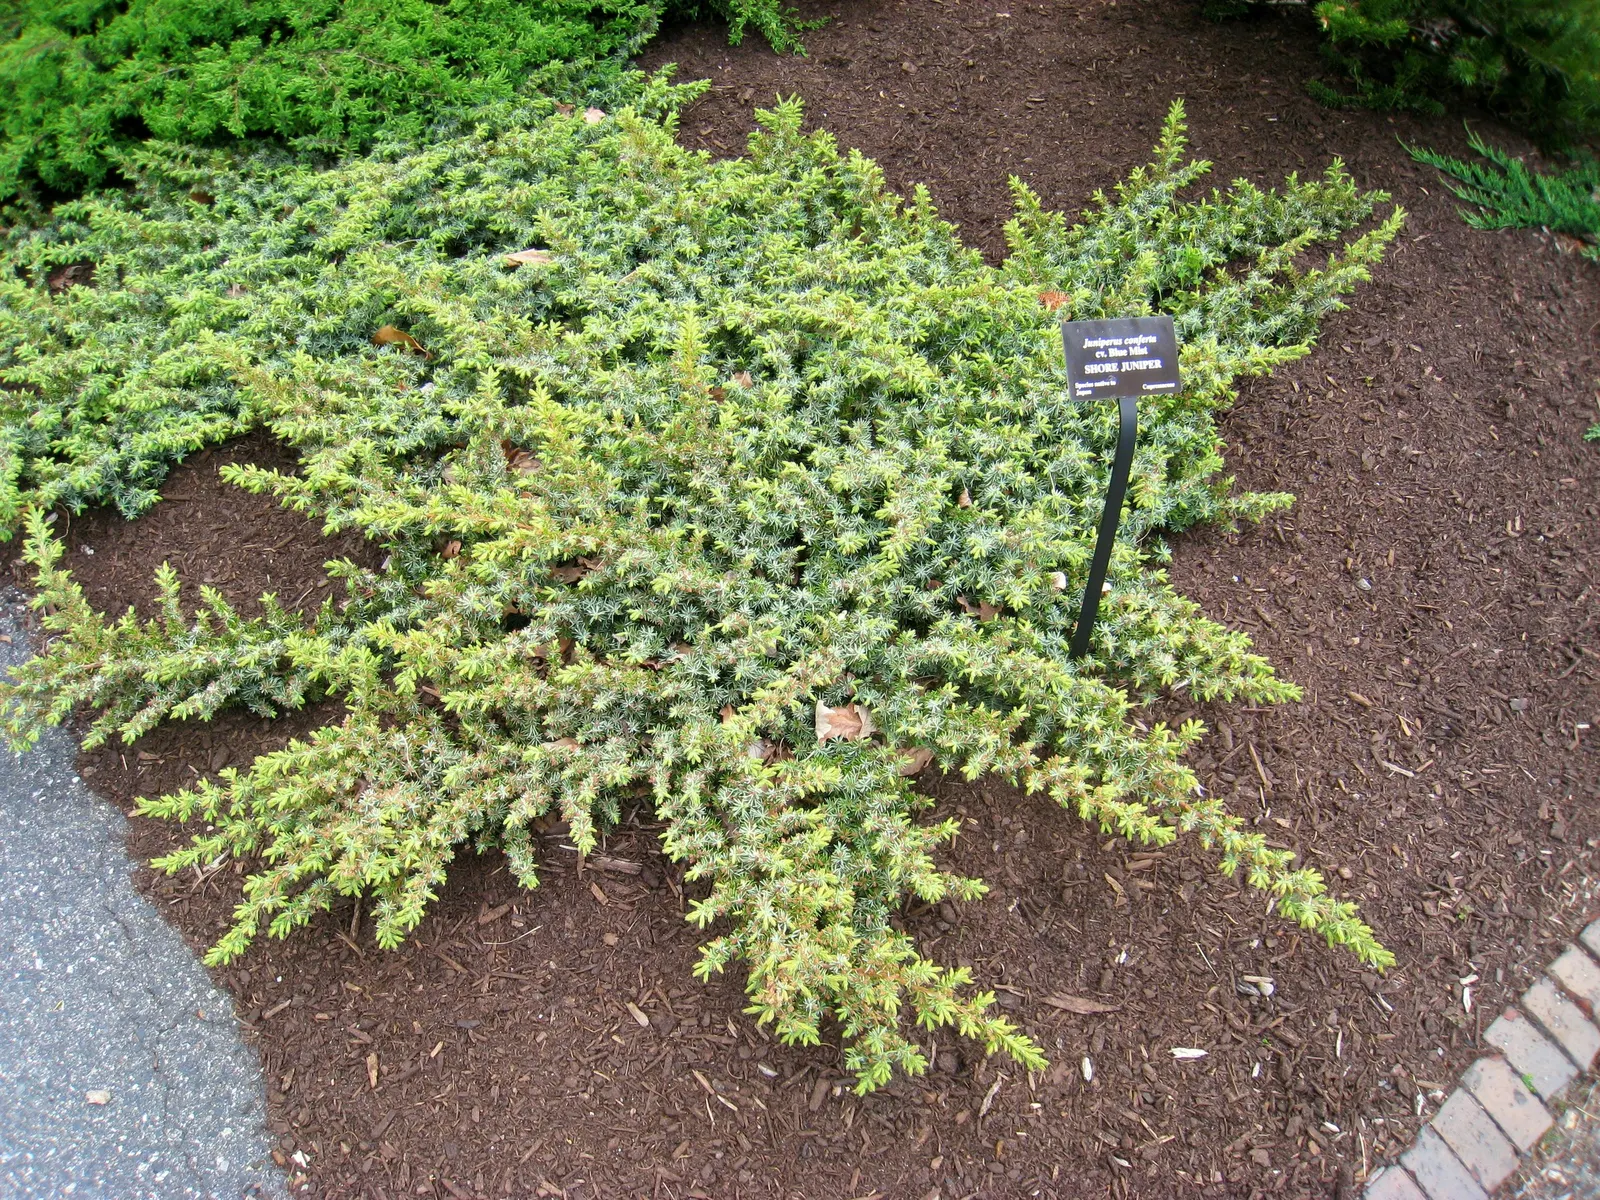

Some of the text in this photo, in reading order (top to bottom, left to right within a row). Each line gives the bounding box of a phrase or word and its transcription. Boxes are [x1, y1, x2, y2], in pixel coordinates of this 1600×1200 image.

[1083, 334, 1157, 349] Juniperus conferta
[1108, 348, 1128, 357] Blue
[1129, 345, 1148, 356] Mist
[1084, 359, 1162, 374] SHORE JUNIPER
